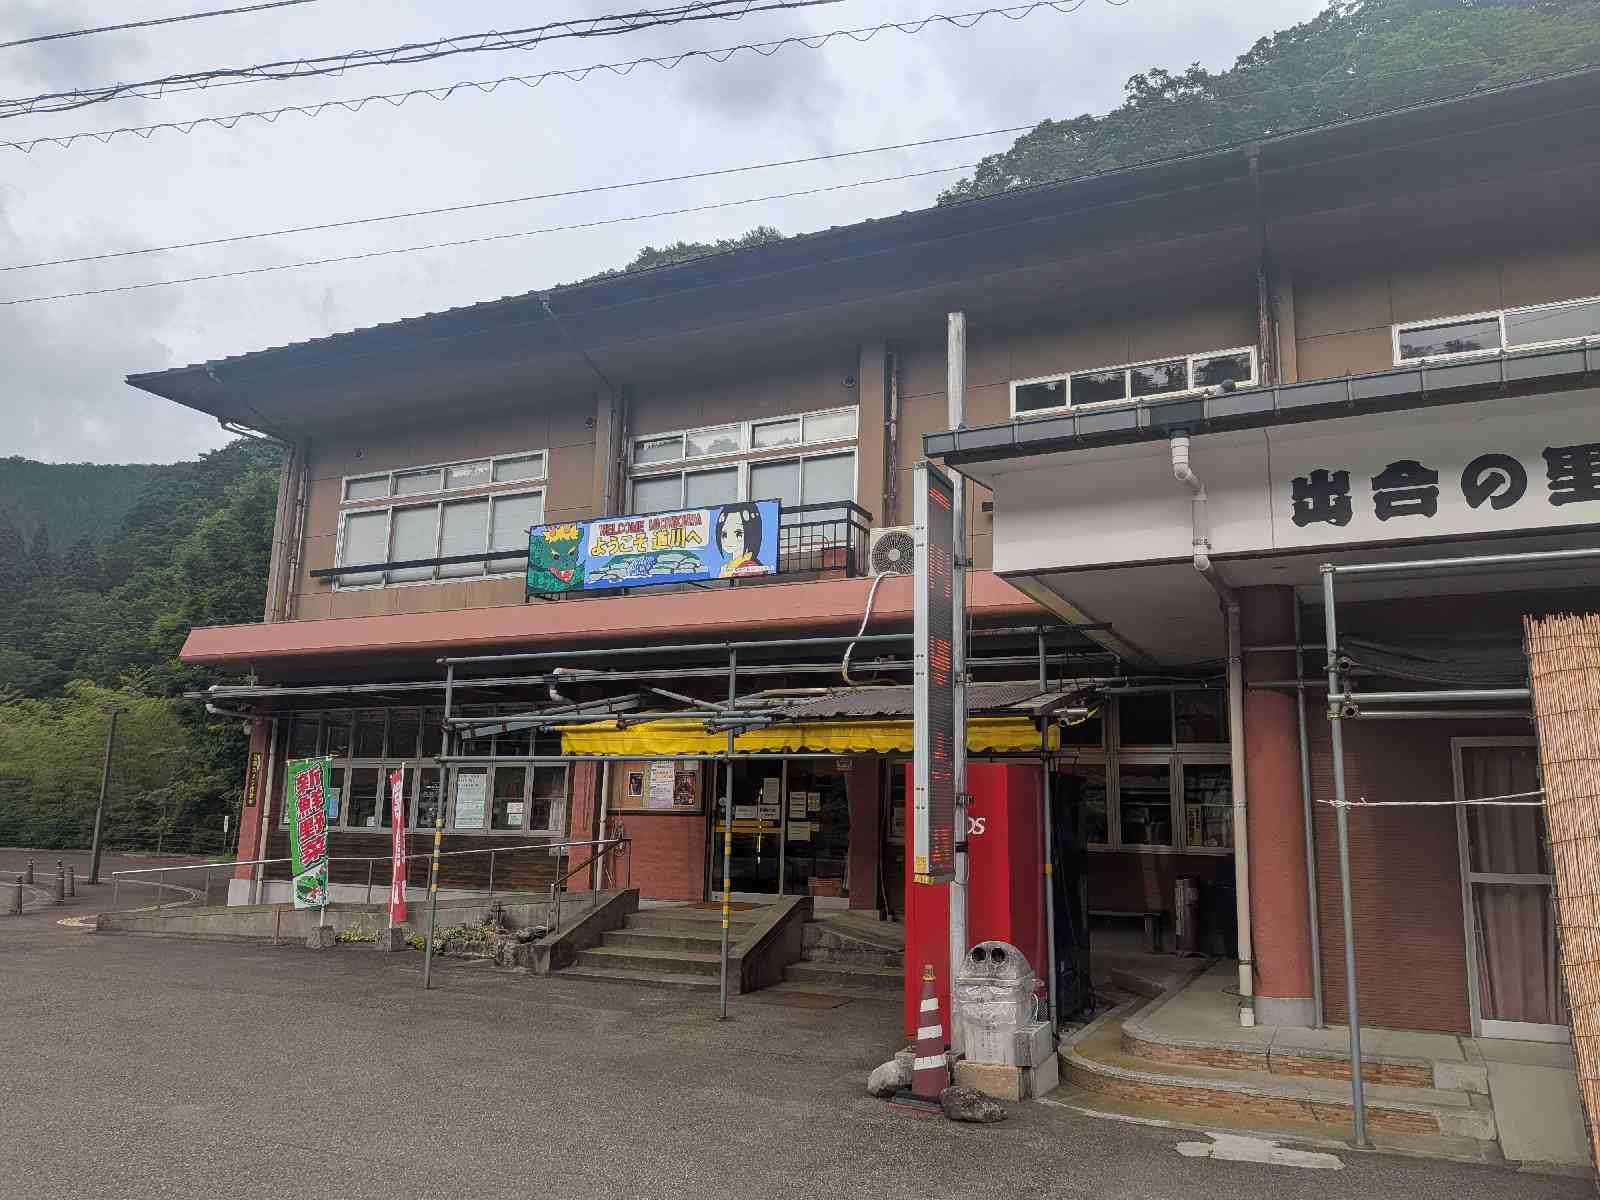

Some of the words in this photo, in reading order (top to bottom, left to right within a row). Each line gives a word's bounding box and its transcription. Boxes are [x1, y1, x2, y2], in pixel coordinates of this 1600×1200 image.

[1291, 443, 1600, 527] 出合の里
[591, 533, 648, 556] ようこそ
[599, 520, 645, 536] WELCOME
[295, 765, 327, 866] 新鮮野菜
